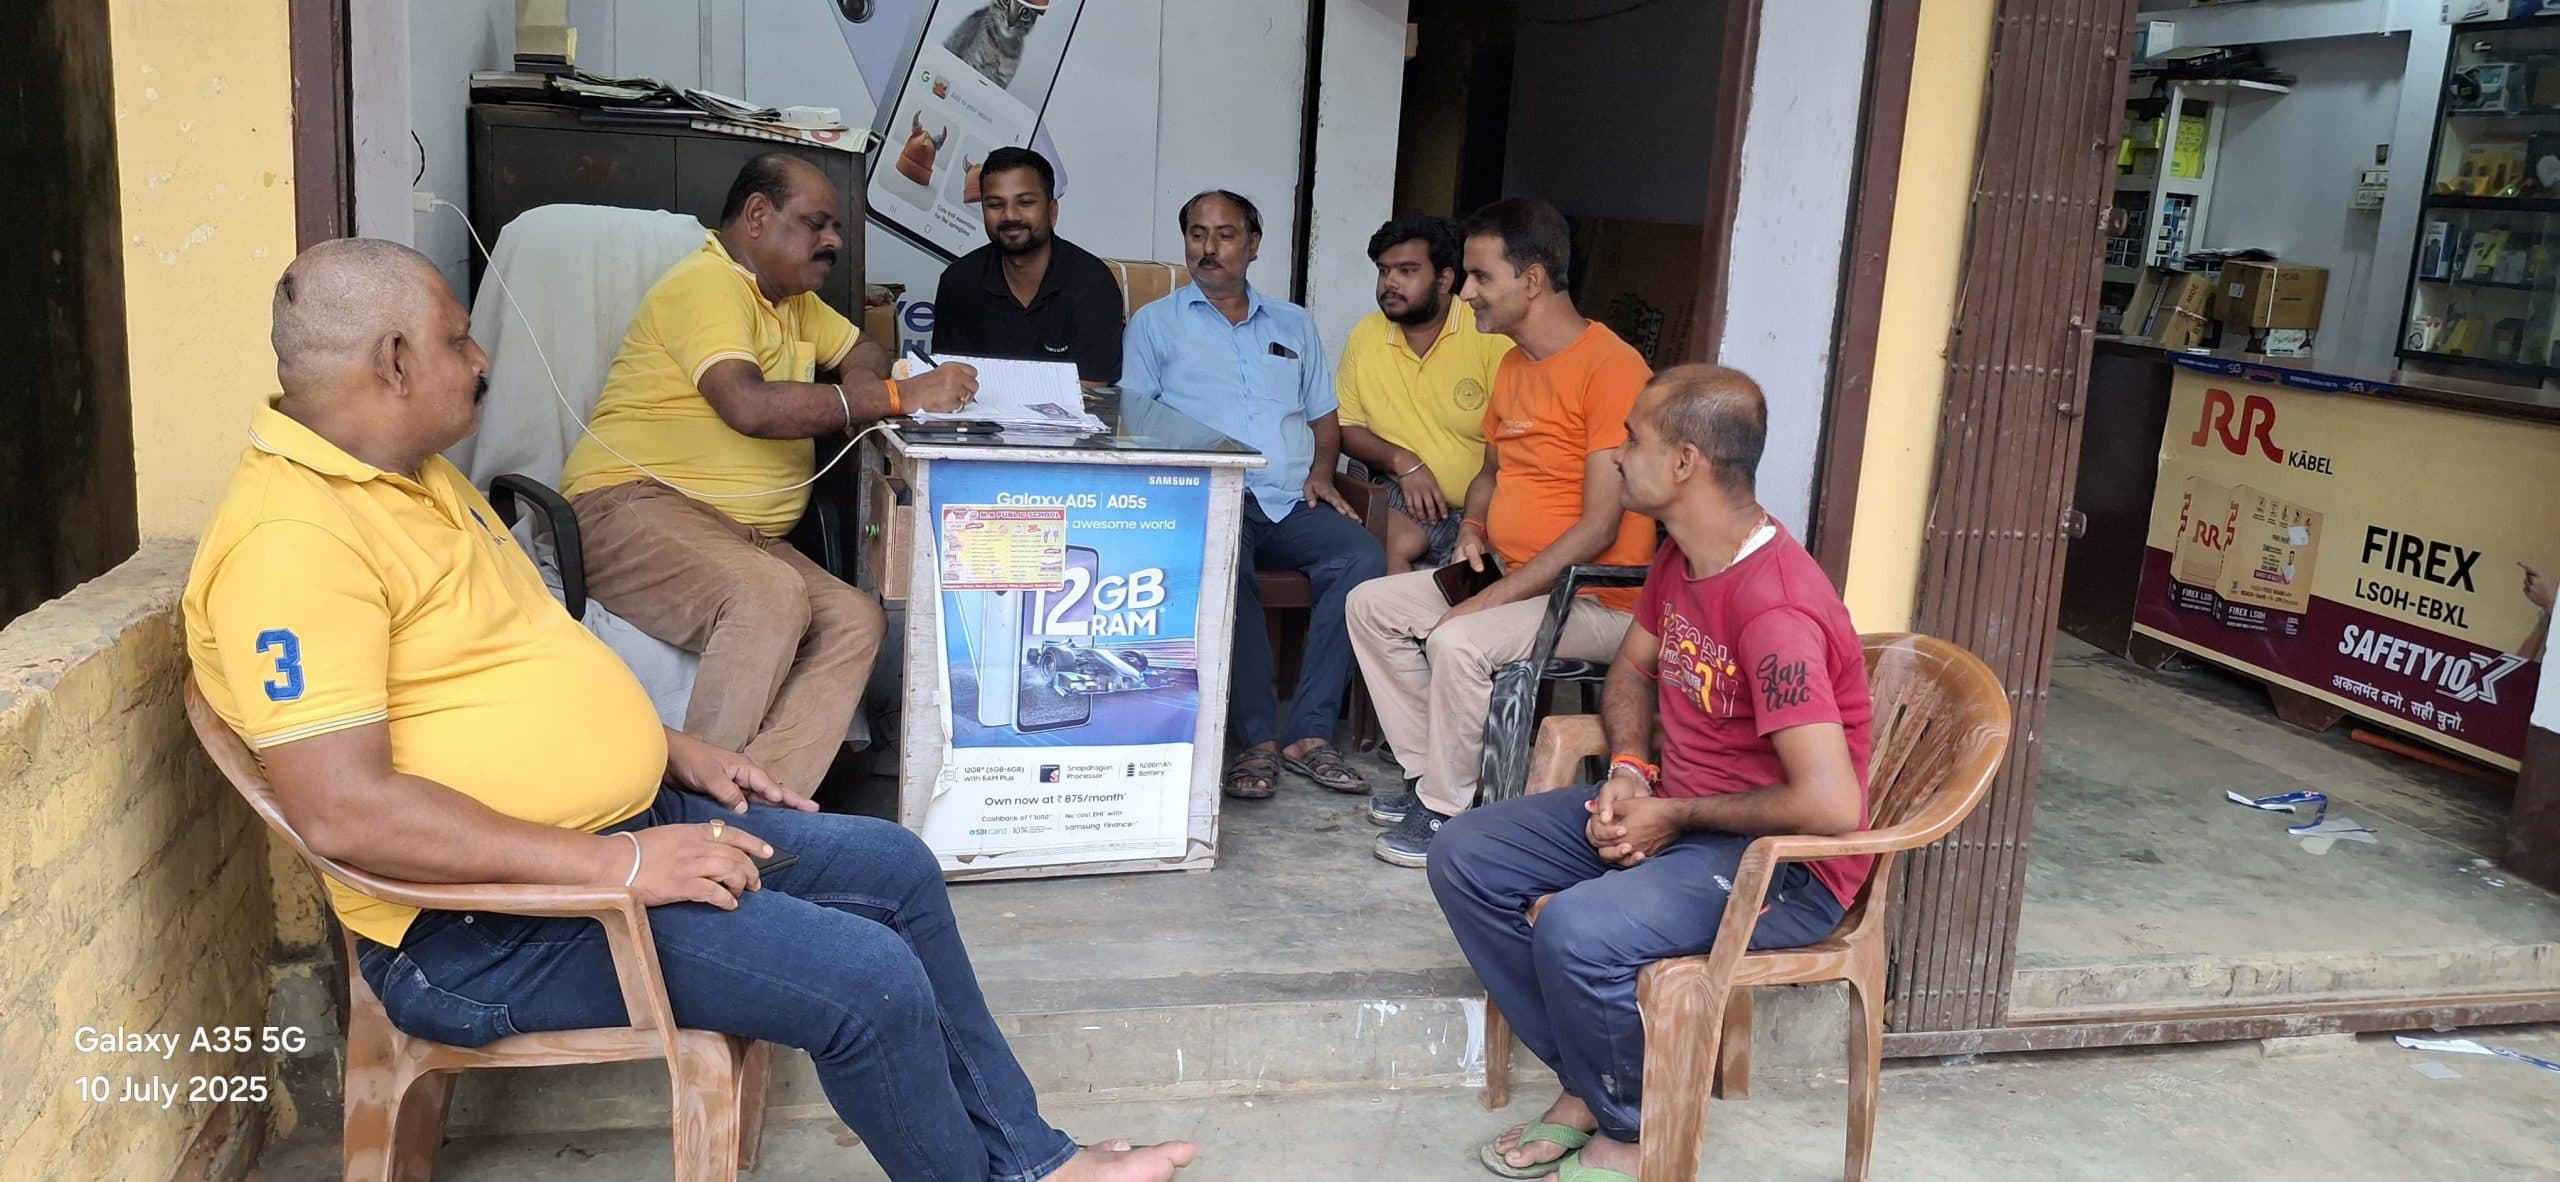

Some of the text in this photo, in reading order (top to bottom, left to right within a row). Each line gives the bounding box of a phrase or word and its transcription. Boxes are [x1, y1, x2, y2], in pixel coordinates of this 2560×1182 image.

[2191, 388, 2284, 464] RR
[1149, 476, 1199, 486] SAMSUNG
[1065, 494, 1096, 508] A05
[1107, 495, 1147, 509] A05s
[1072, 520, 1136, 529] awesome
[1141, 519, 1176, 530] world
[2192, 519, 2222, 552] RR
[2361, 525, 2482, 593] FIREX
[2355, 578, 2469, 629] LSOH-EBXL
[255, 628, 305, 701] 3
[2411, 701, 2435, 721] सही
[984, 797, 1012, 806] Own
[1014, 797, 1040, 805] now
[1042, 796, 1054, 804] at
